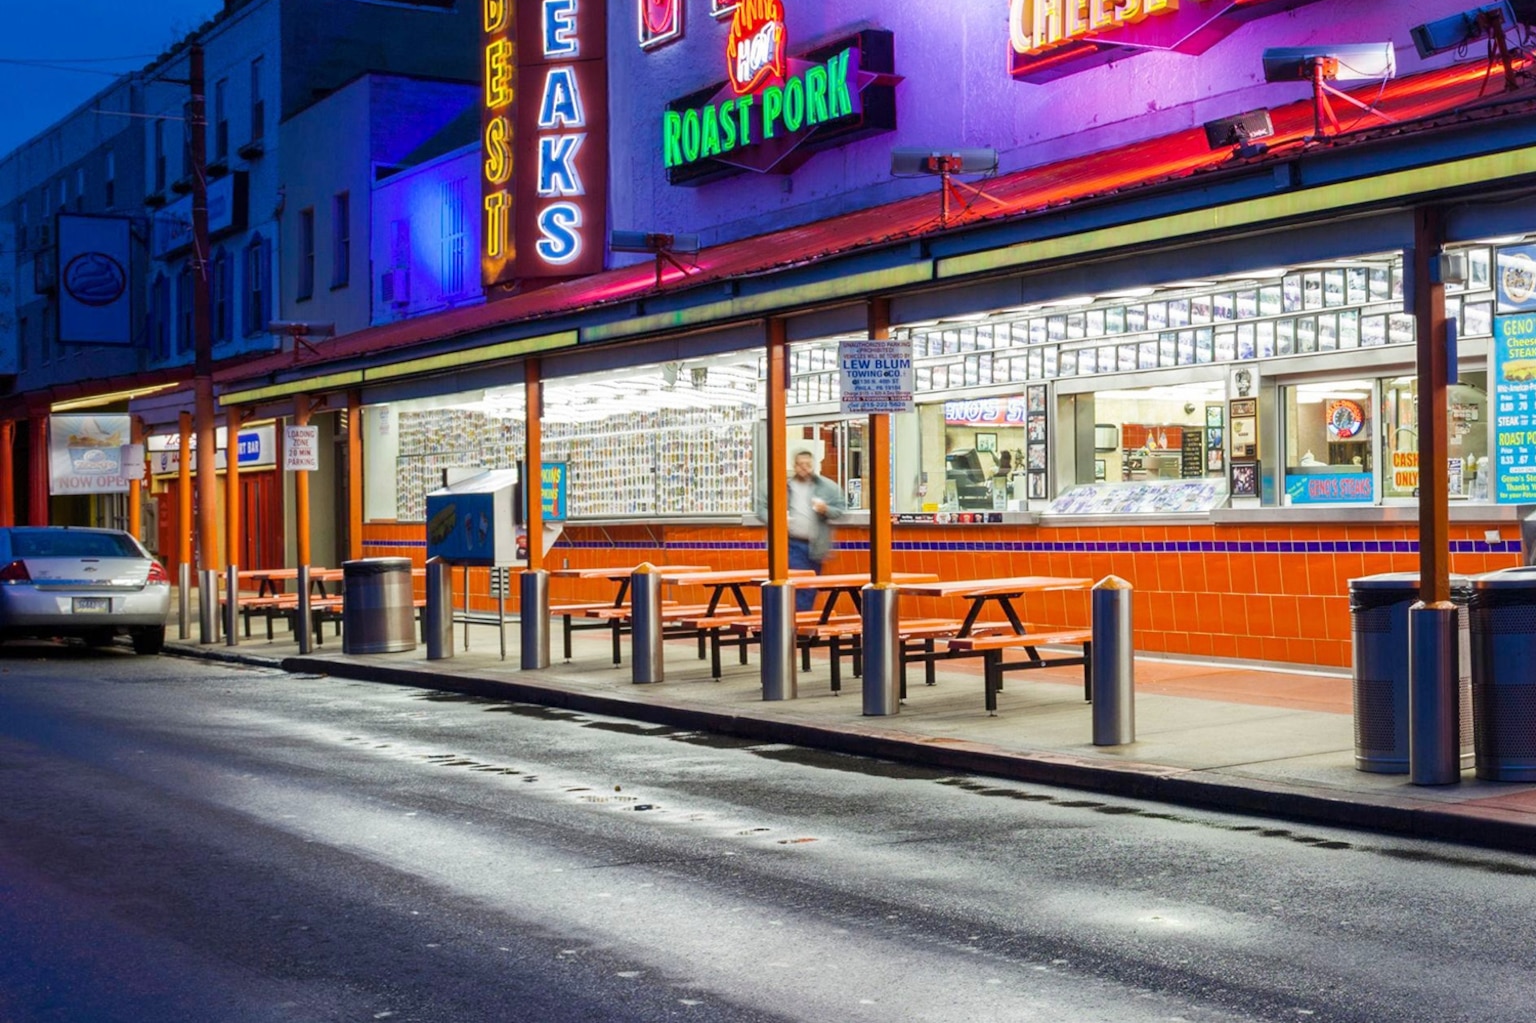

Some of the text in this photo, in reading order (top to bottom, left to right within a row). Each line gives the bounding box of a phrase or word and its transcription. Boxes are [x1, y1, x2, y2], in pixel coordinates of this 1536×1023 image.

[737, 20, 775, 83] HOT
[664, 47, 852, 170] ROAST PORK
[843, 359, 910, 369] LEW BLUM
[288, 430, 314, 438] LOADING
[1499, 432, 1525, 446] ROAST
[247, 440, 259, 454] BAR
[293, 438, 309, 446] ZONE
[60, 476, 92, 489] NOW
[1395, 472, 1418, 487] ONLY
[1309, 479, 1338, 496] GENO'S
[1340, 478, 1371, 496] STEAKS
